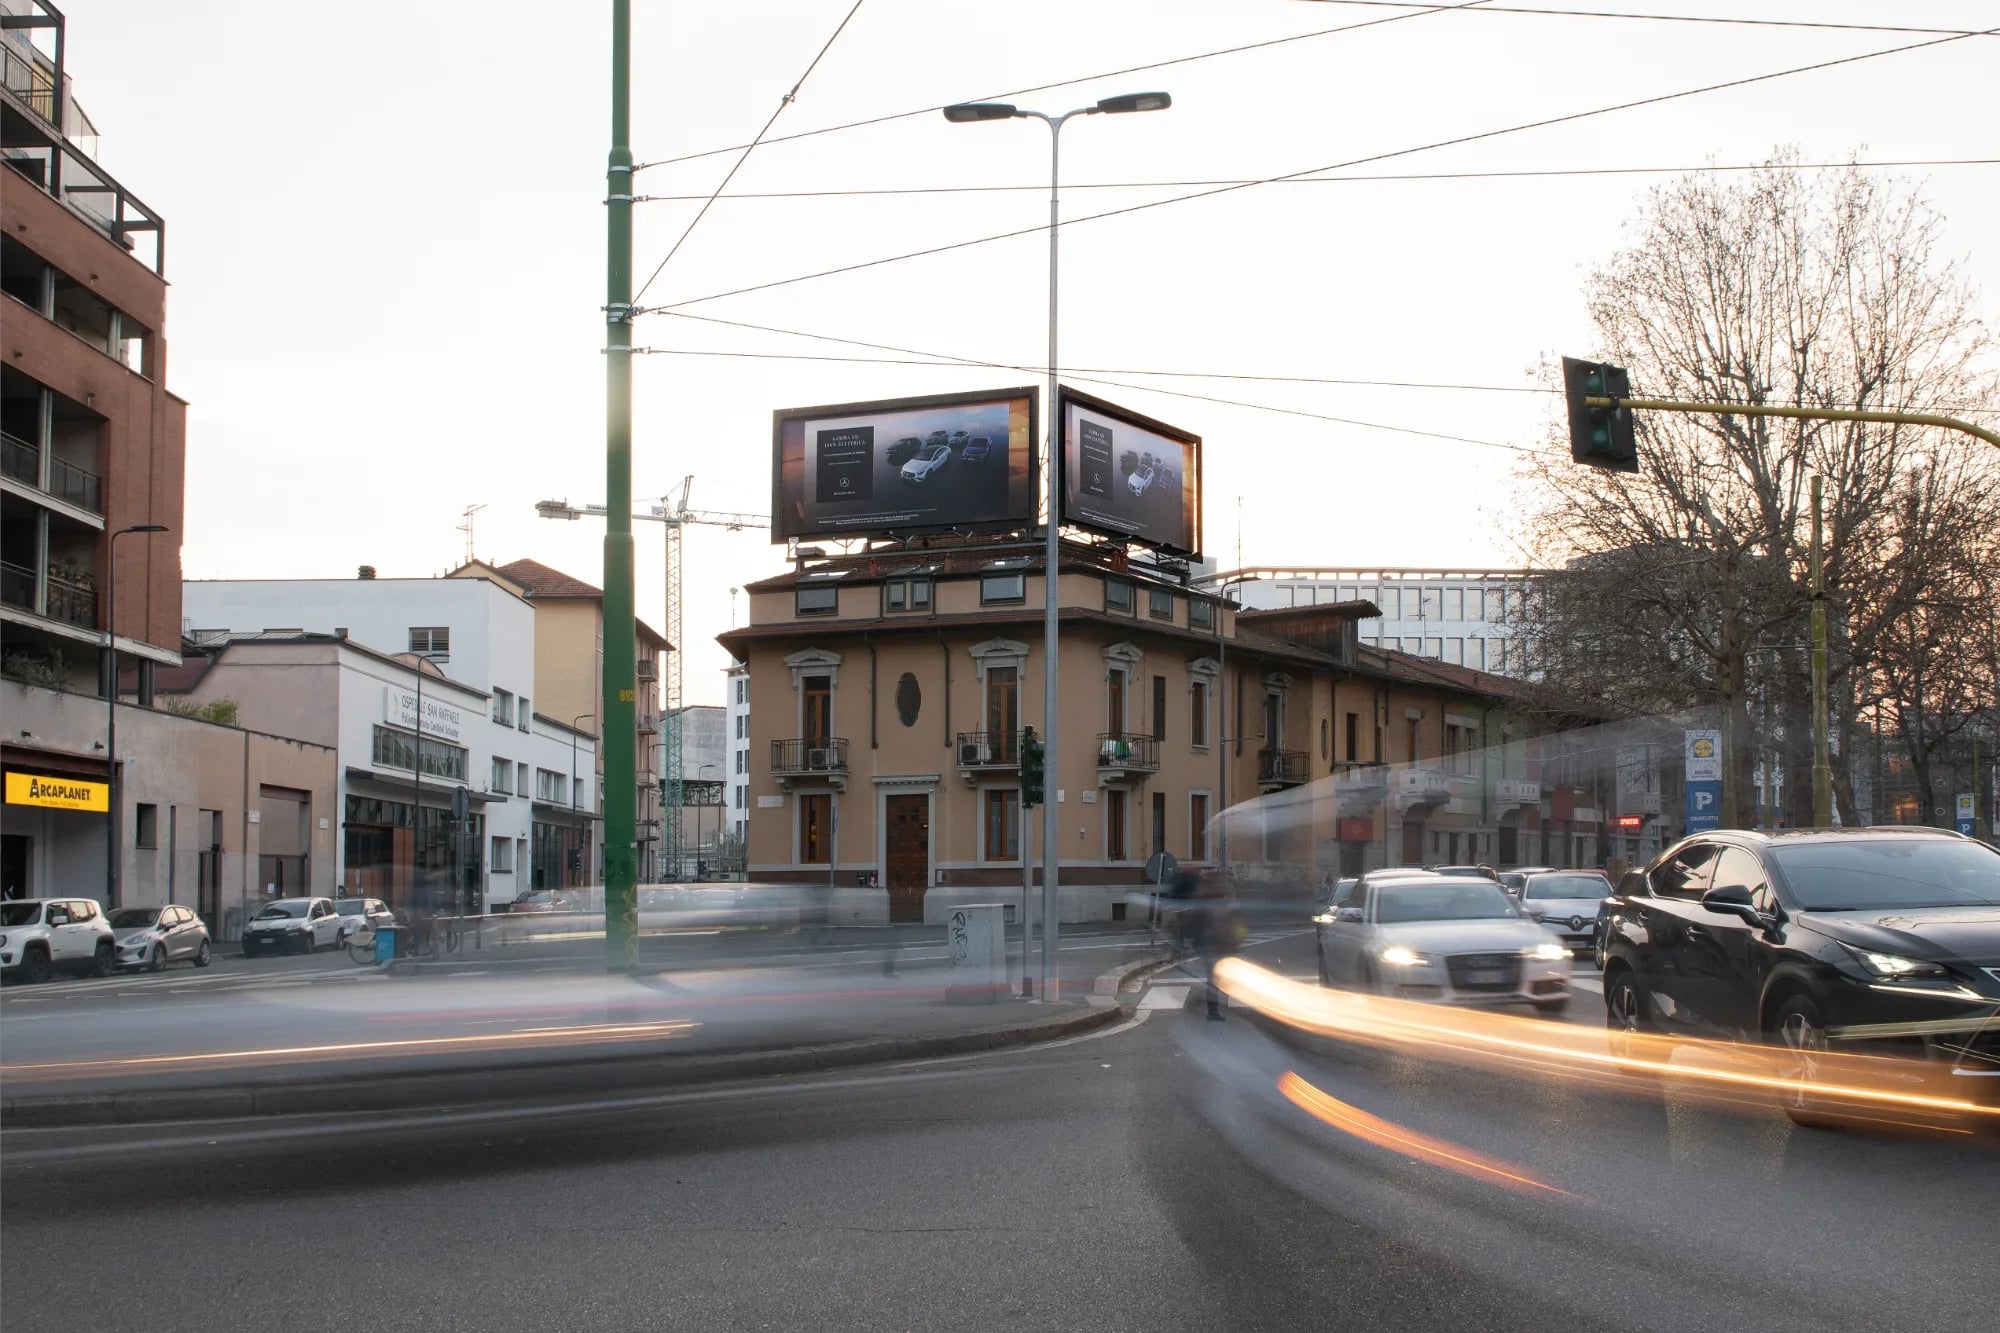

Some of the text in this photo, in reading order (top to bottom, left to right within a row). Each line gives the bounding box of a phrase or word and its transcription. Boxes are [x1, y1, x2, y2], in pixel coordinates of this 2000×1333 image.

[402, 695, 460, 725] OSPELE SAN RAFFAELE
[29, 778, 91, 801] ARCAPLANET
[1695, 791, 1713, 810] P
